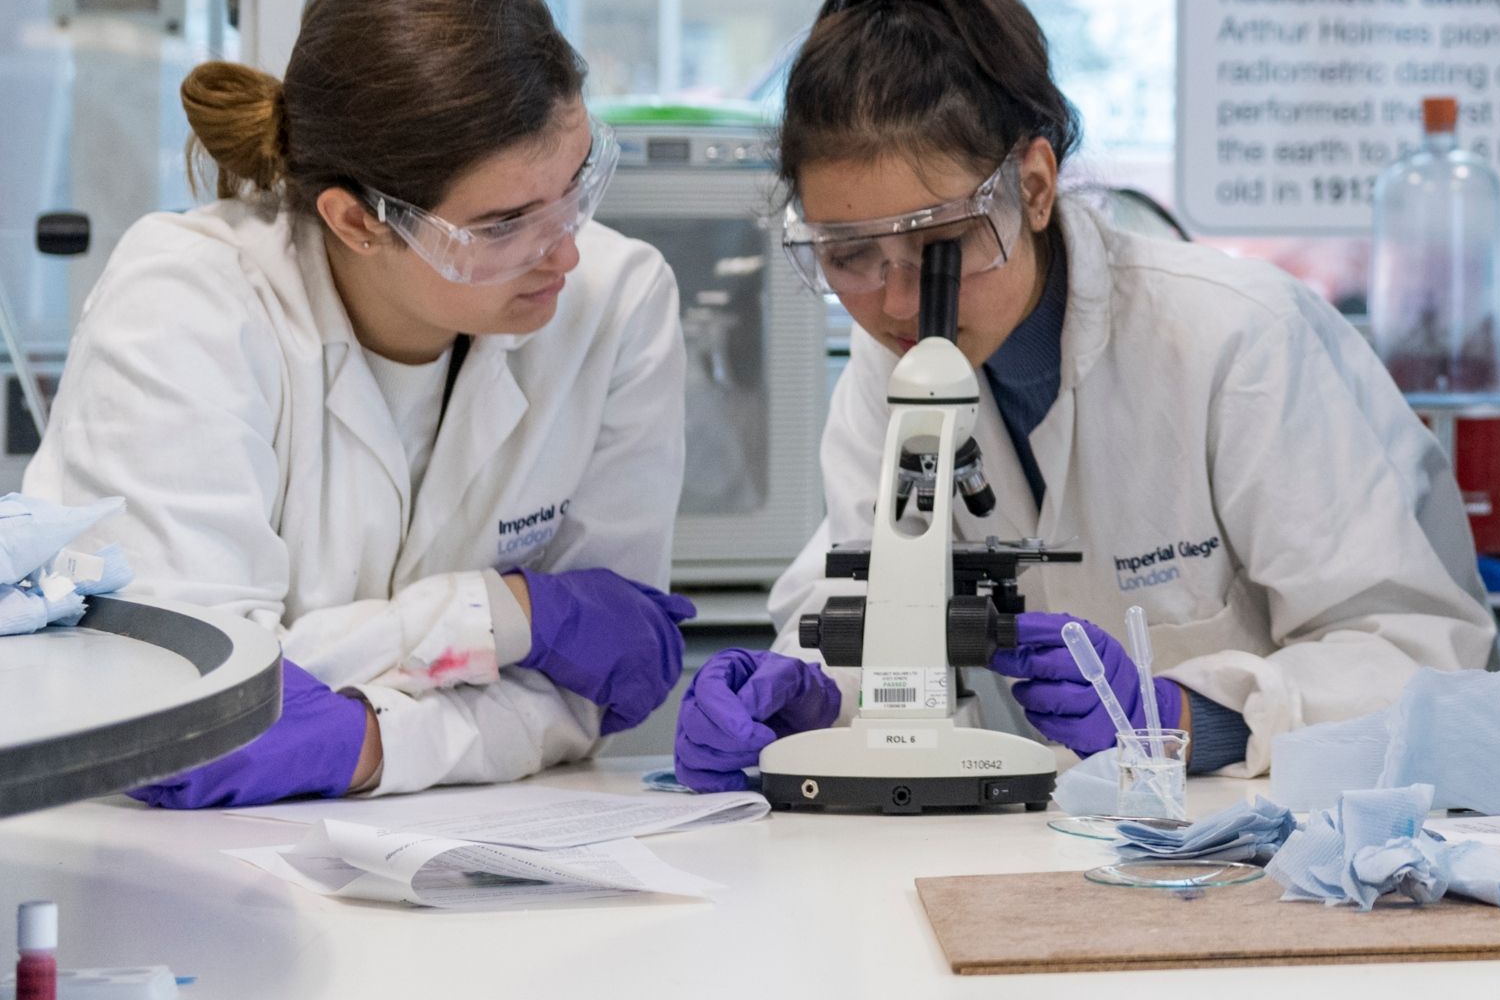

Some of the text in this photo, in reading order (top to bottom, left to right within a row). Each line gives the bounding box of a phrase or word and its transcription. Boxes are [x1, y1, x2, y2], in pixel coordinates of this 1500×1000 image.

[1216, 14, 1312, 44] Arthur
[1318, 15, 1431, 46] Holmes
[1216, 53, 1387, 84] radiometric
[1395, 56, 1489, 93] dating
[1216, 94, 1375, 129] performed
[1216, 137, 1265, 166] the
[1273, 137, 1352, 167] earth
[1358, 138, 1392, 167] to
[1215, 173, 1266, 205] old
[1271, 176, 1301, 206] in
[498, 504, 556, 535] Imperial
[496, 527, 553, 556] London
[1113, 542, 1176, 574] Imperial
[1117, 566, 1181, 592] London
[886, 735, 916, 744] ROL 6
[961, 759, 1003, 770] 1310642
